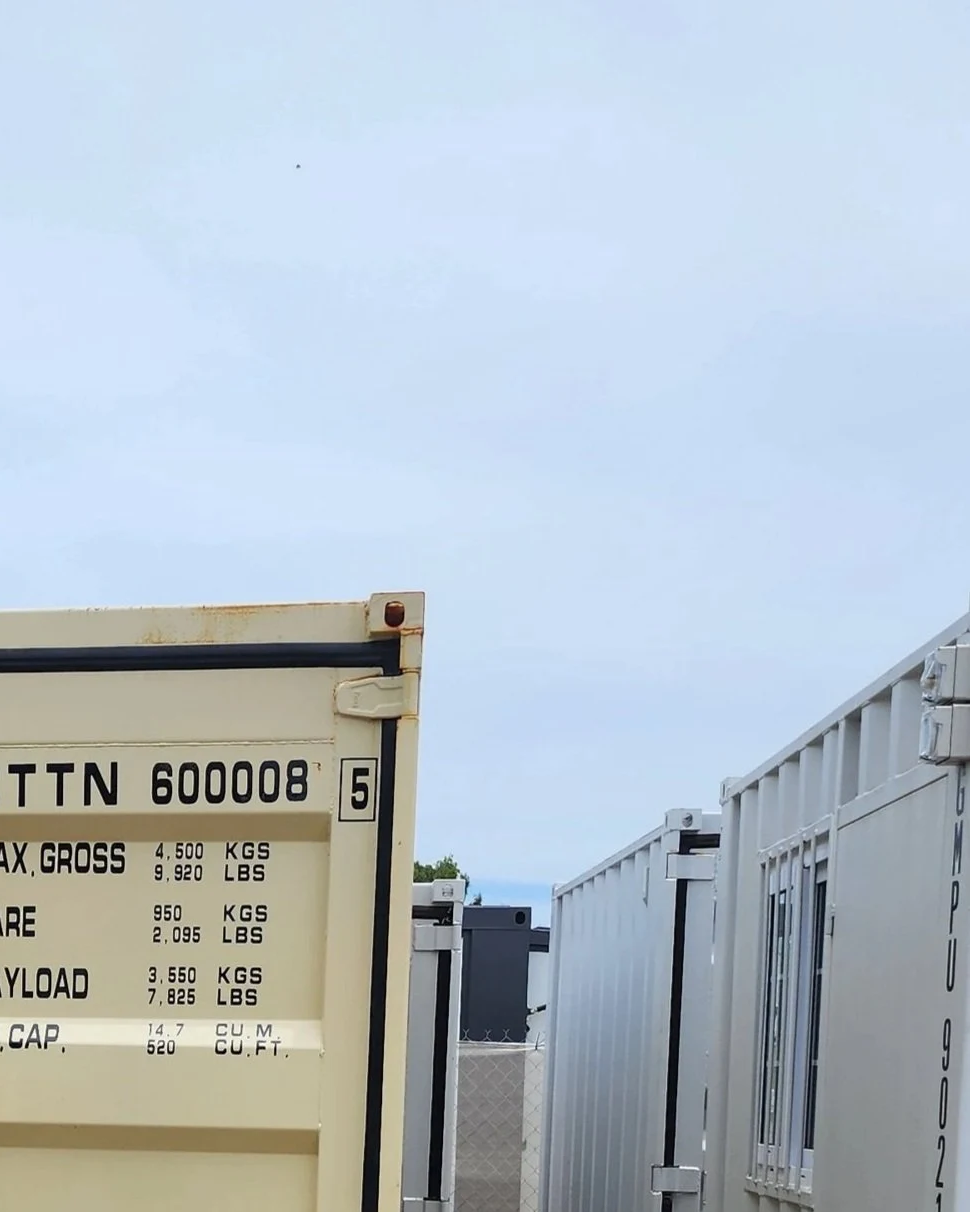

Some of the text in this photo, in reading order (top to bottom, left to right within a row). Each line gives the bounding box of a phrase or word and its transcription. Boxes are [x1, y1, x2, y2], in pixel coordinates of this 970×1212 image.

[151, 759, 309, 805] 600008
[350, 767, 369, 810] 5
[225, 842, 270, 860] KGS
[154, 863, 265, 883] 9,920 LBS
[153, 904, 182, 922] 950
[223, 904, 268, 923] KGS
[152, 926, 263, 945] 2,095 LBS
[217, 966, 262, 985] KGS
[147, 988, 258, 1006] 7,825 LBS
[148, 1023, 184, 1037] 14.7
[146, 1039, 176, 1055] 520
